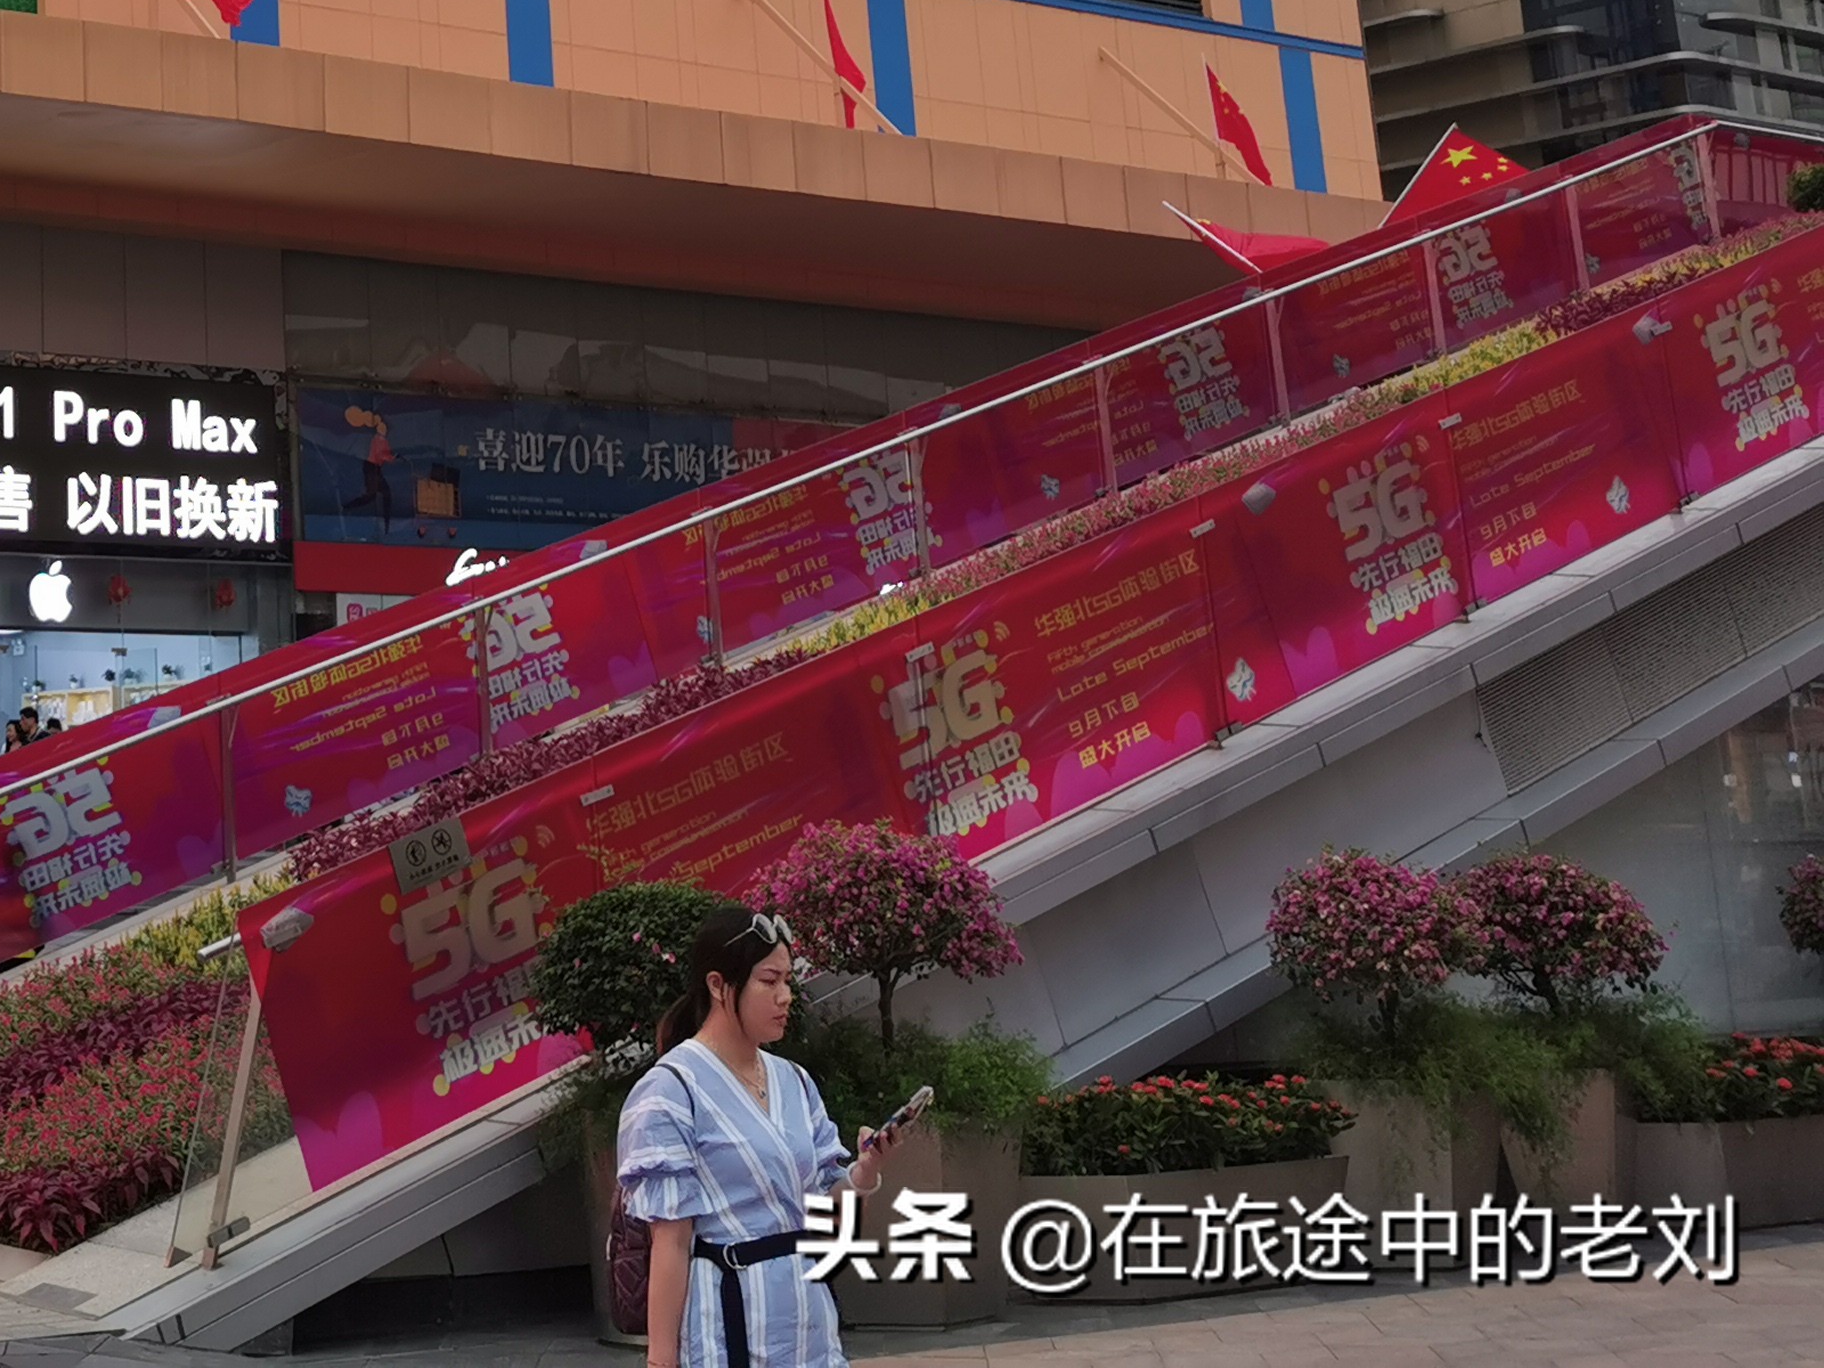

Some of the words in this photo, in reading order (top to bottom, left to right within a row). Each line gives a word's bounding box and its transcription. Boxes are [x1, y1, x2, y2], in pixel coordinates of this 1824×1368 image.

[1706, 299, 1782, 387] 5G
[53, 391, 144, 446] Pro
[171, 399, 257, 453] Max
[1728, 365, 1796, 414] 先行福田
[477, 428, 624, 478] 喜迎70年
[1514, 443, 1596, 487] September
[66, 472, 279, 542] 以旧换新
[1333, 460, 1425, 561] 5G
[1480, 502, 1537, 540] 9月下旬
[1358, 533, 1443, 591] 先行福田
[1490, 528, 1547, 567] 盛大开启
[1034, 548, 1199, 638] 华强北5G体验街区
[1369, 567, 1454, 625] 极速未来
[1057, 672, 1108, 702] Late
[1113, 622, 1215, 677] September
[888, 649, 999, 770] 5G
[1069, 692, 1140, 738] 9月下旬
[915, 732, 1021, 803] 先行福田
[1078, 721, 1151, 769] 盛大开启
[401, 858, 540, 1001] 5G
[428, 957, 538, 1038] 先行福
[440, 1014, 549, 1082] 极速未
